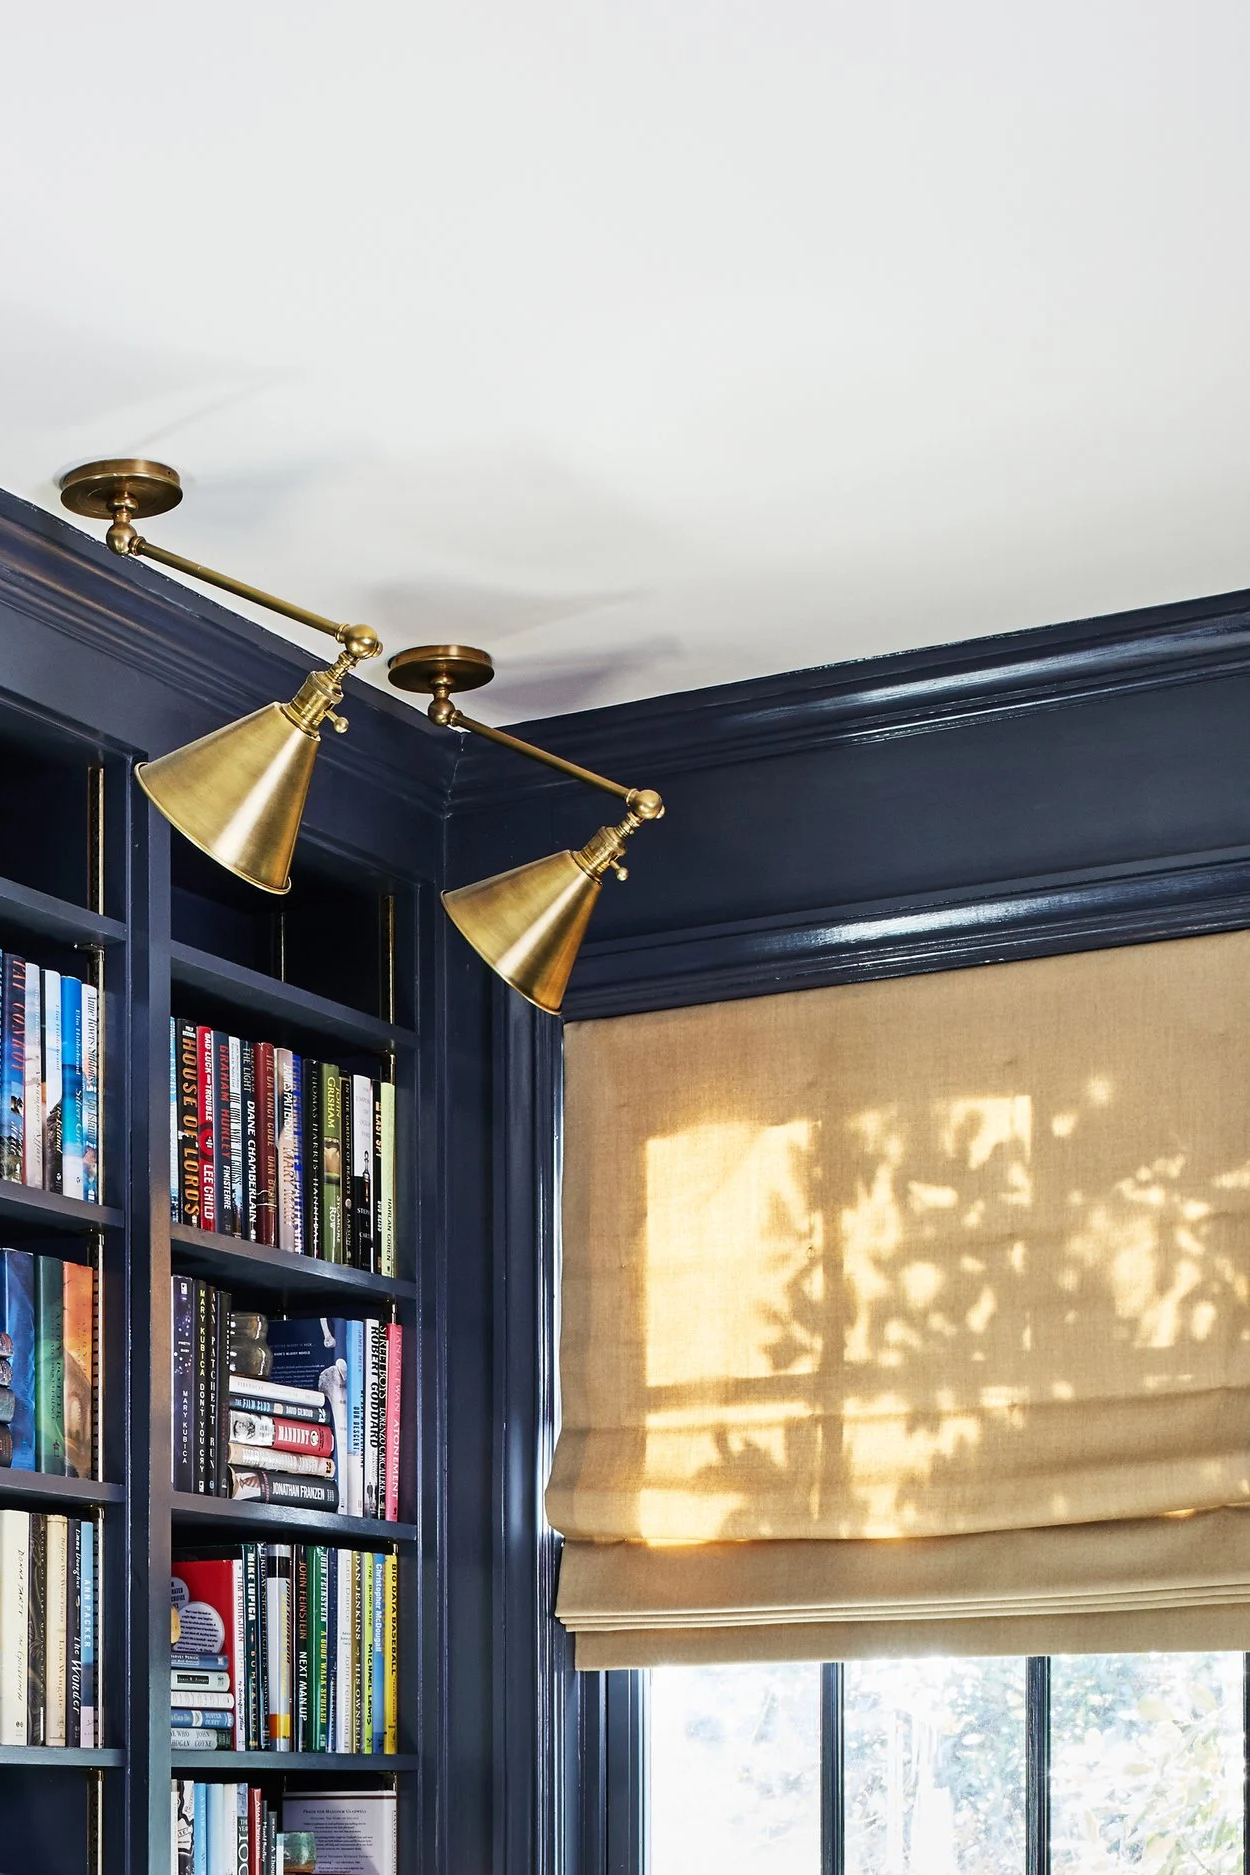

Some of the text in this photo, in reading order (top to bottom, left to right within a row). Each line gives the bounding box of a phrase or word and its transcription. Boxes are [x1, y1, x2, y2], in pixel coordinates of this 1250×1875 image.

[11, 960, 26, 1072] PAT CONROY
[182, 1038, 197, 1108] HOUSE
[243, 1065, 251, 1093] LIGHT
[311, 1069, 319, 1118] THOMAS
[183, 1115, 198, 1138] OF
[205, 1085, 213, 1122] TROUBLE
[219, 1045, 231, 1159] GRAHAM HURLEY
[283, 1091, 294, 1140] PATTERSON
[327, 1077, 336, 1128] GRISHAM
[267, 1122, 275, 1147] CODE
[183, 1147, 200, 1216] LORDS
[223, 1165, 232, 1210] FINISTERRE
[247, 1100, 257, 1223] DIANE CHAMBERLAIN
[204, 1164, 214, 1220] LEE CHILD
[242, 1398, 270, 1412] FILM CLUB
[370, 1326, 380, 1449] ROBERT GODDARD
[277, 1425, 310, 1446] MANHUNT
[353, 1420, 361, 1451] DESCENT
[392, 1420, 400, 1499] ATONEMENT
[272, 1481, 325, 1501] JONATHAN FRANZEN
[17, 1549, 25, 1580] DONNA
[247, 1552, 256, 1621] MIKE LUPICA
[83, 1579, 91, 1648] ANN PACKER
[298, 1560, 307, 1640] JOHN FEINSTEIN
[374, 1563, 383, 1652] Christopher McDougall
[71, 1636, 82, 1715] The Wonder
[298, 1651, 308, 1722] NEXT MAN UP
[319, 1662, 327, 1685] WALK
